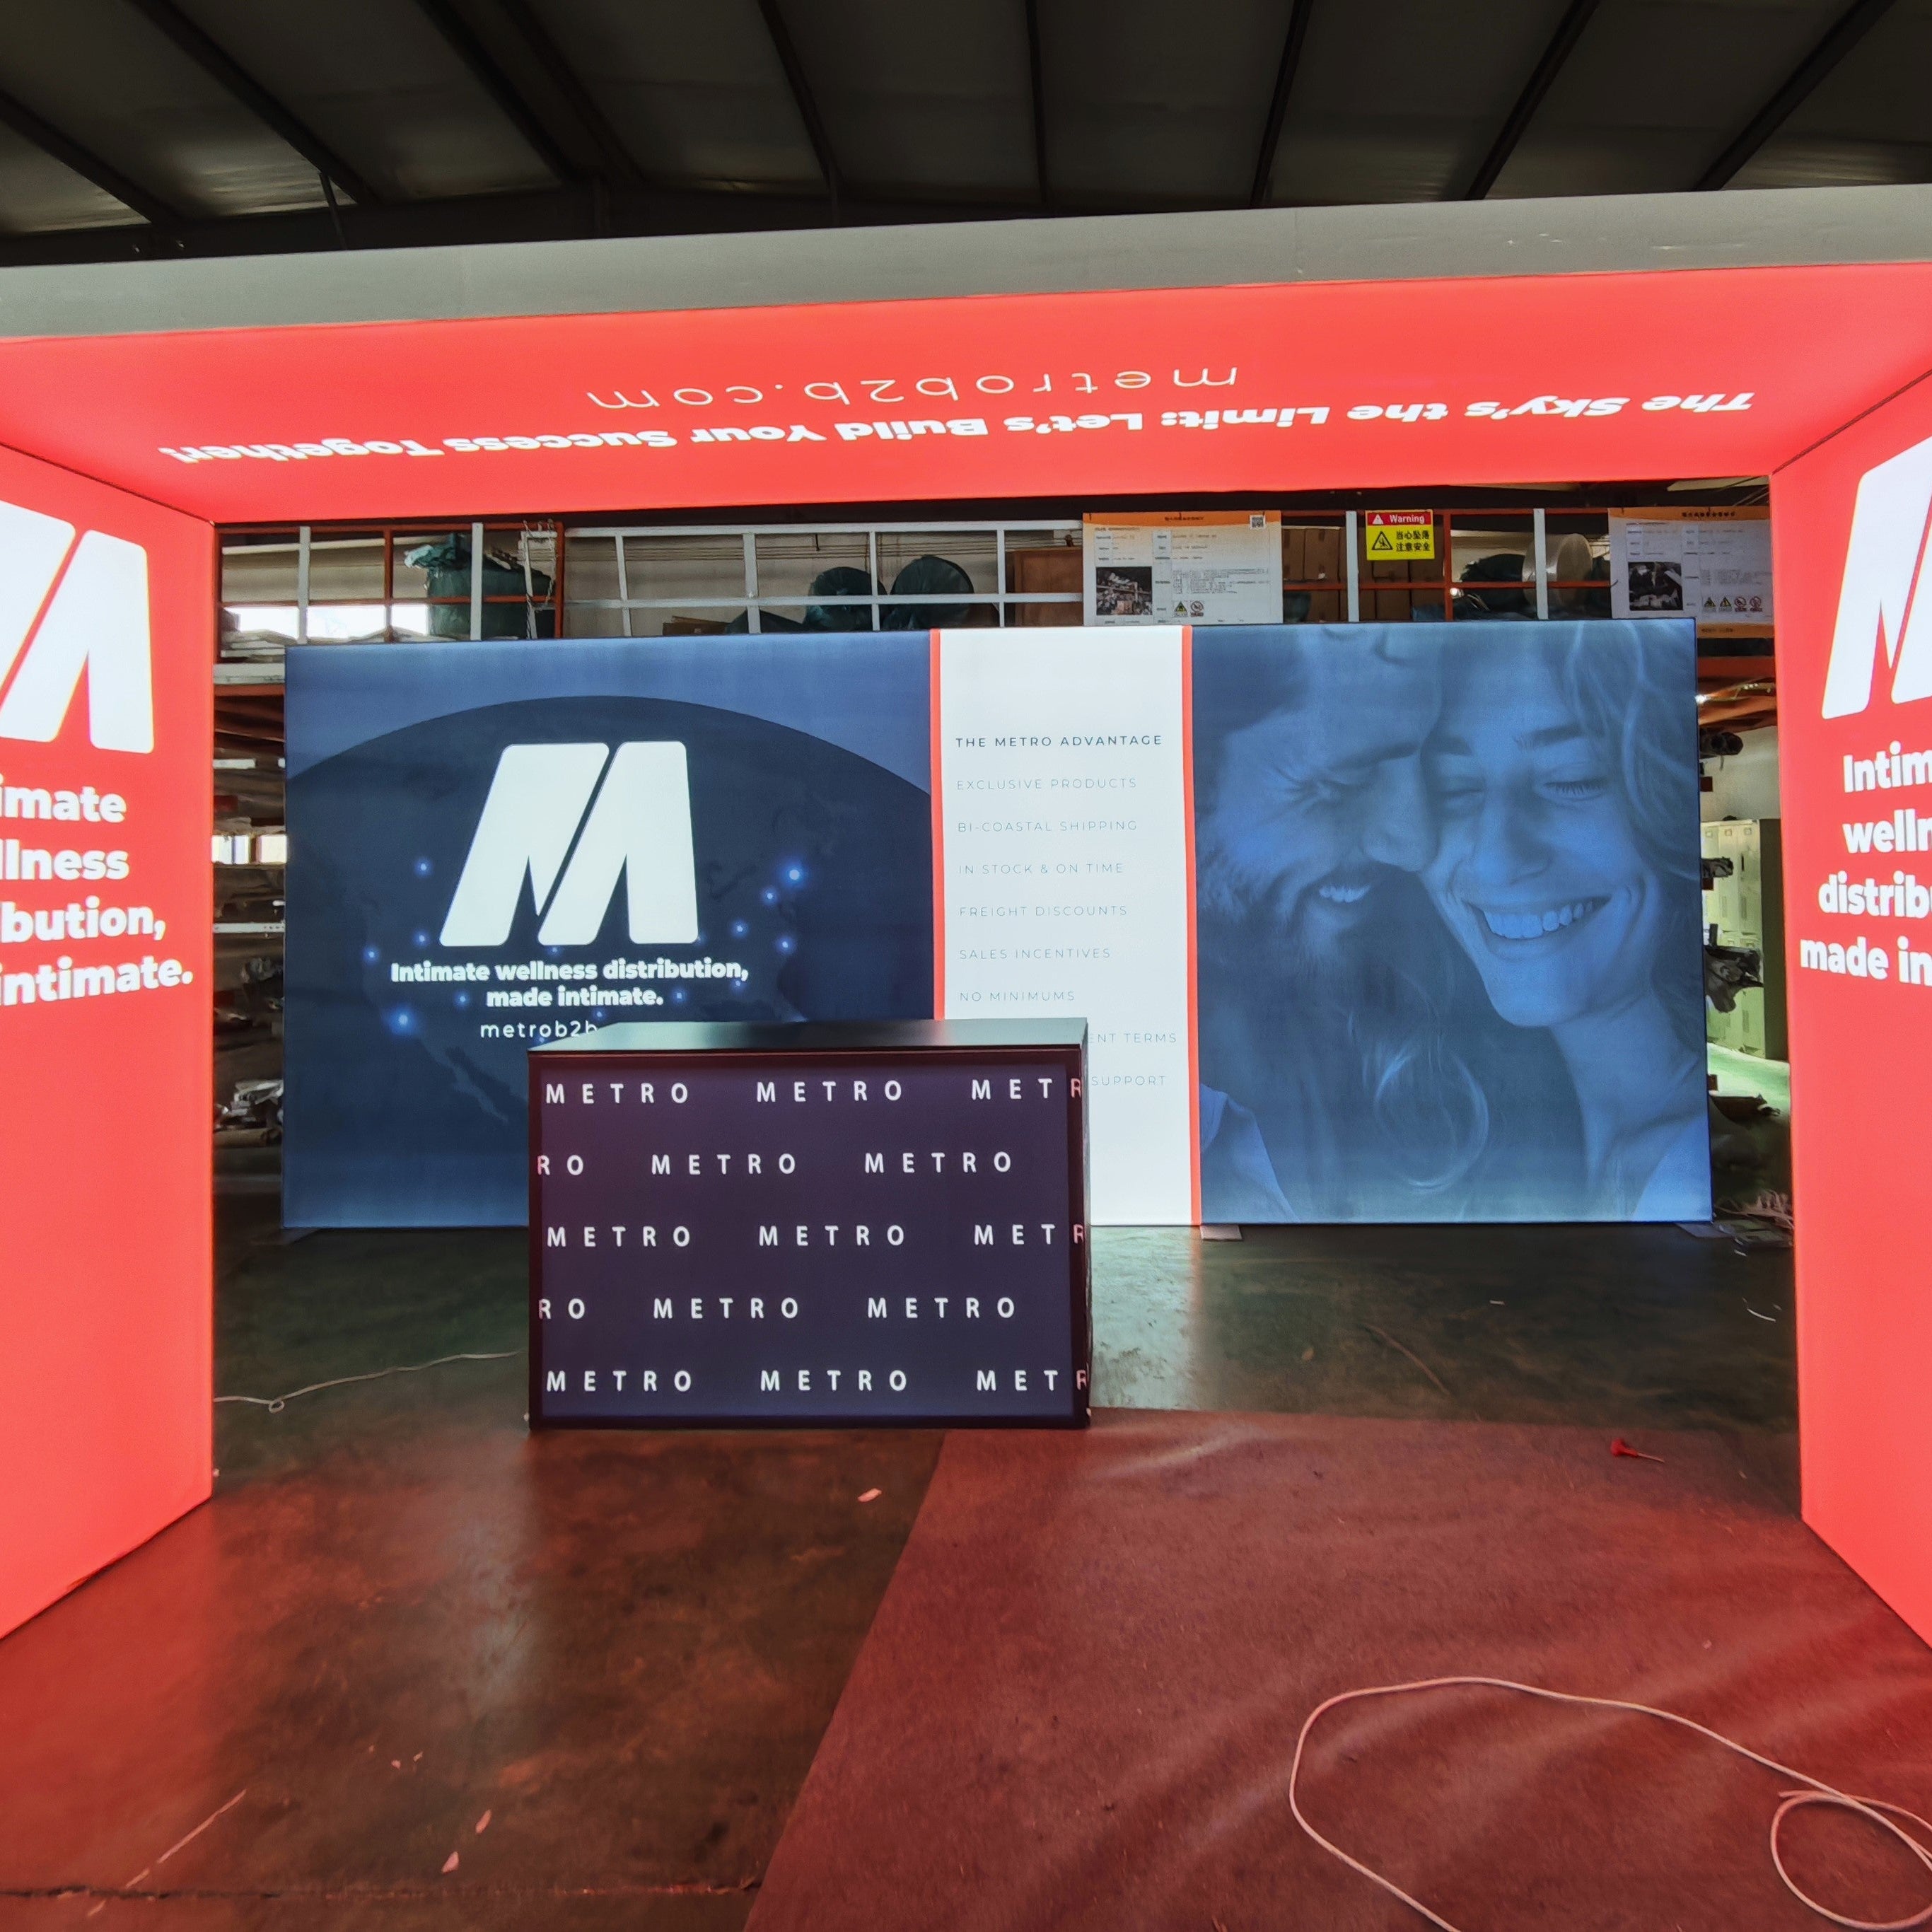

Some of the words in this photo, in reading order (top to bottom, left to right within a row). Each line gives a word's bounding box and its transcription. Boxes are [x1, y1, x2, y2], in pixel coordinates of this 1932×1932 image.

[587, 368, 1237, 408] metrob2b.com
[1347, 402, 1449, 422] the
[1465, 396, 1631, 420] Sky's
[1642, 392, 1754, 413] The
[834, 418, 989, 441] Build
[1003, 412, 1143, 434] Let's
[1160, 407, 1330, 430] Limit:
[443, 430, 677, 455] Success
[690, 424, 827, 443] Your
[1389, 514, 1425, 524] Warning
[1396, 542, 1430, 552] 注意安全
[955, 738, 987, 748] THE
[994, 736, 1052, 747] METRO
[1059, 735, 1162, 747] ADVANTAGE
[957, 779, 1042, 791] EXCLUSIVE
[1051, 778, 1136, 790] PRODUCTS
[0, 773, 127, 823] mate
[958, 821, 1052, 833] BI-COASTAL
[1059, 820, 1137, 832] SHIPPING
[0, 838, 129, 880] lness
[959, 865, 974, 875] IN
[982, 863, 1032, 875] STOCK
[1040, 863, 1048, 874] &
[1056, 863, 1078, 874] ON
[1086, 863, 1124, 873] TIME
[1818, 870, 1932, 919] distrib
[960, 906, 1028, 917] FREIGHT
[1035, 905, 1127, 916] DISCOUNTS
[960, 948, 1008, 960] SALES
[1016, 948, 1110, 960] INCENTIVES
[1800, 936, 1890, 980] made
[391, 960, 491, 982] Intimate
[495, 960, 598, 981] wellness
[603, 956, 749, 982] distribution,
[0, 955, 193, 1006] ntimate.
[487, 987, 553, 1007] made
[557, 984, 664, 1006] intimate.
[960, 991, 982, 1002] NO
[989, 991, 1075, 1002] MINIMUMS
[1123, 1032, 1177, 1044] TERMS
[1091, 1075, 1166, 1086] SUPPORT
[545, 1082, 688, 1105] METRO
[756, 1080, 902, 1102] METRO
[651, 1153, 796, 1175] METRO
[865, 1151, 1011, 1174] METRO
[547, 1226, 690, 1247] METRO
[759, 1224, 904, 1247] METRO
[653, 1297, 798, 1319] METRO
[867, 1297, 1015, 1319] METRO
[546, 1370, 692, 1392] METRO
[760, 1369, 907, 1392] METRO
